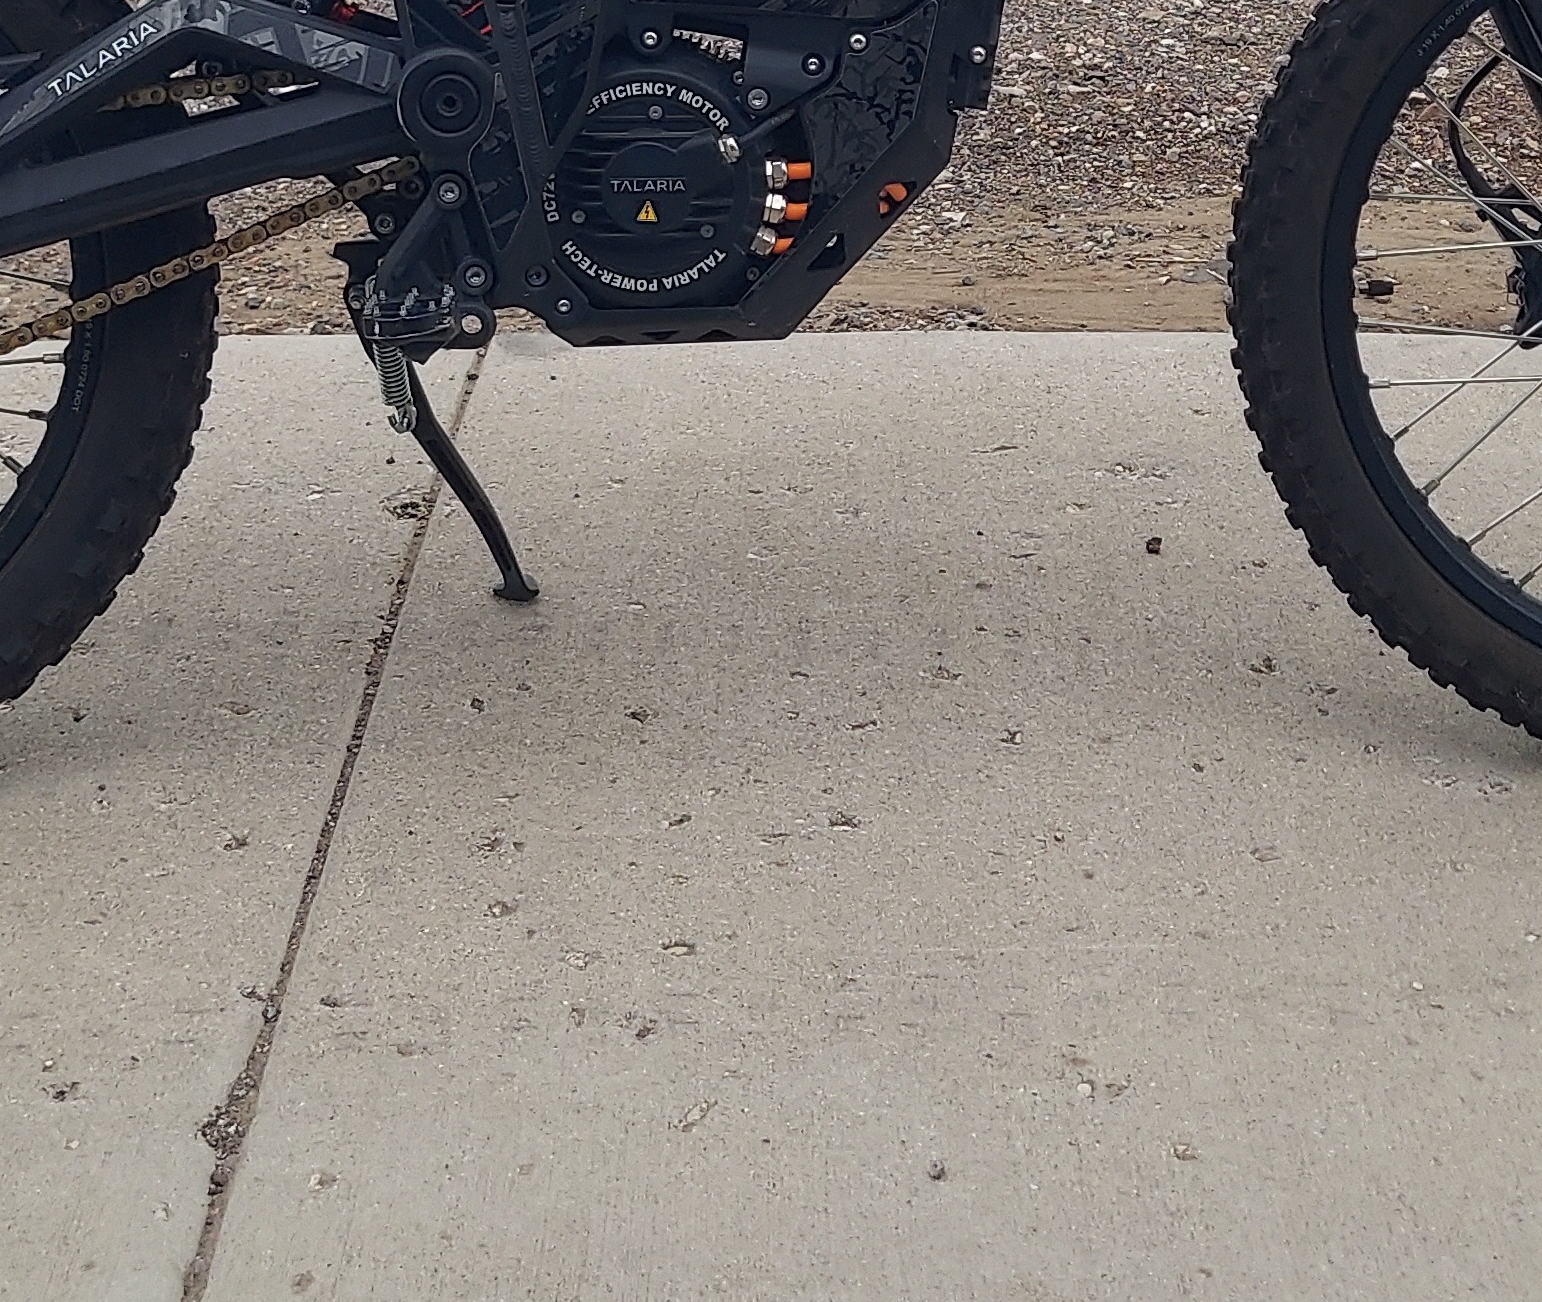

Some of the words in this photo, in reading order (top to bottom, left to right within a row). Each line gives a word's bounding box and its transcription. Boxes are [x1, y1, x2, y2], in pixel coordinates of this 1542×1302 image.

[46, 20, 159, 98] TALARIA
[678, 89, 731, 131] MOTOR
[610, 179, 686, 193] TALARIA
[560, 240, 659, 292] POWER-TECH
[662, 247, 727, 291] TALARIA
[71, 389, 84, 414] DOT
